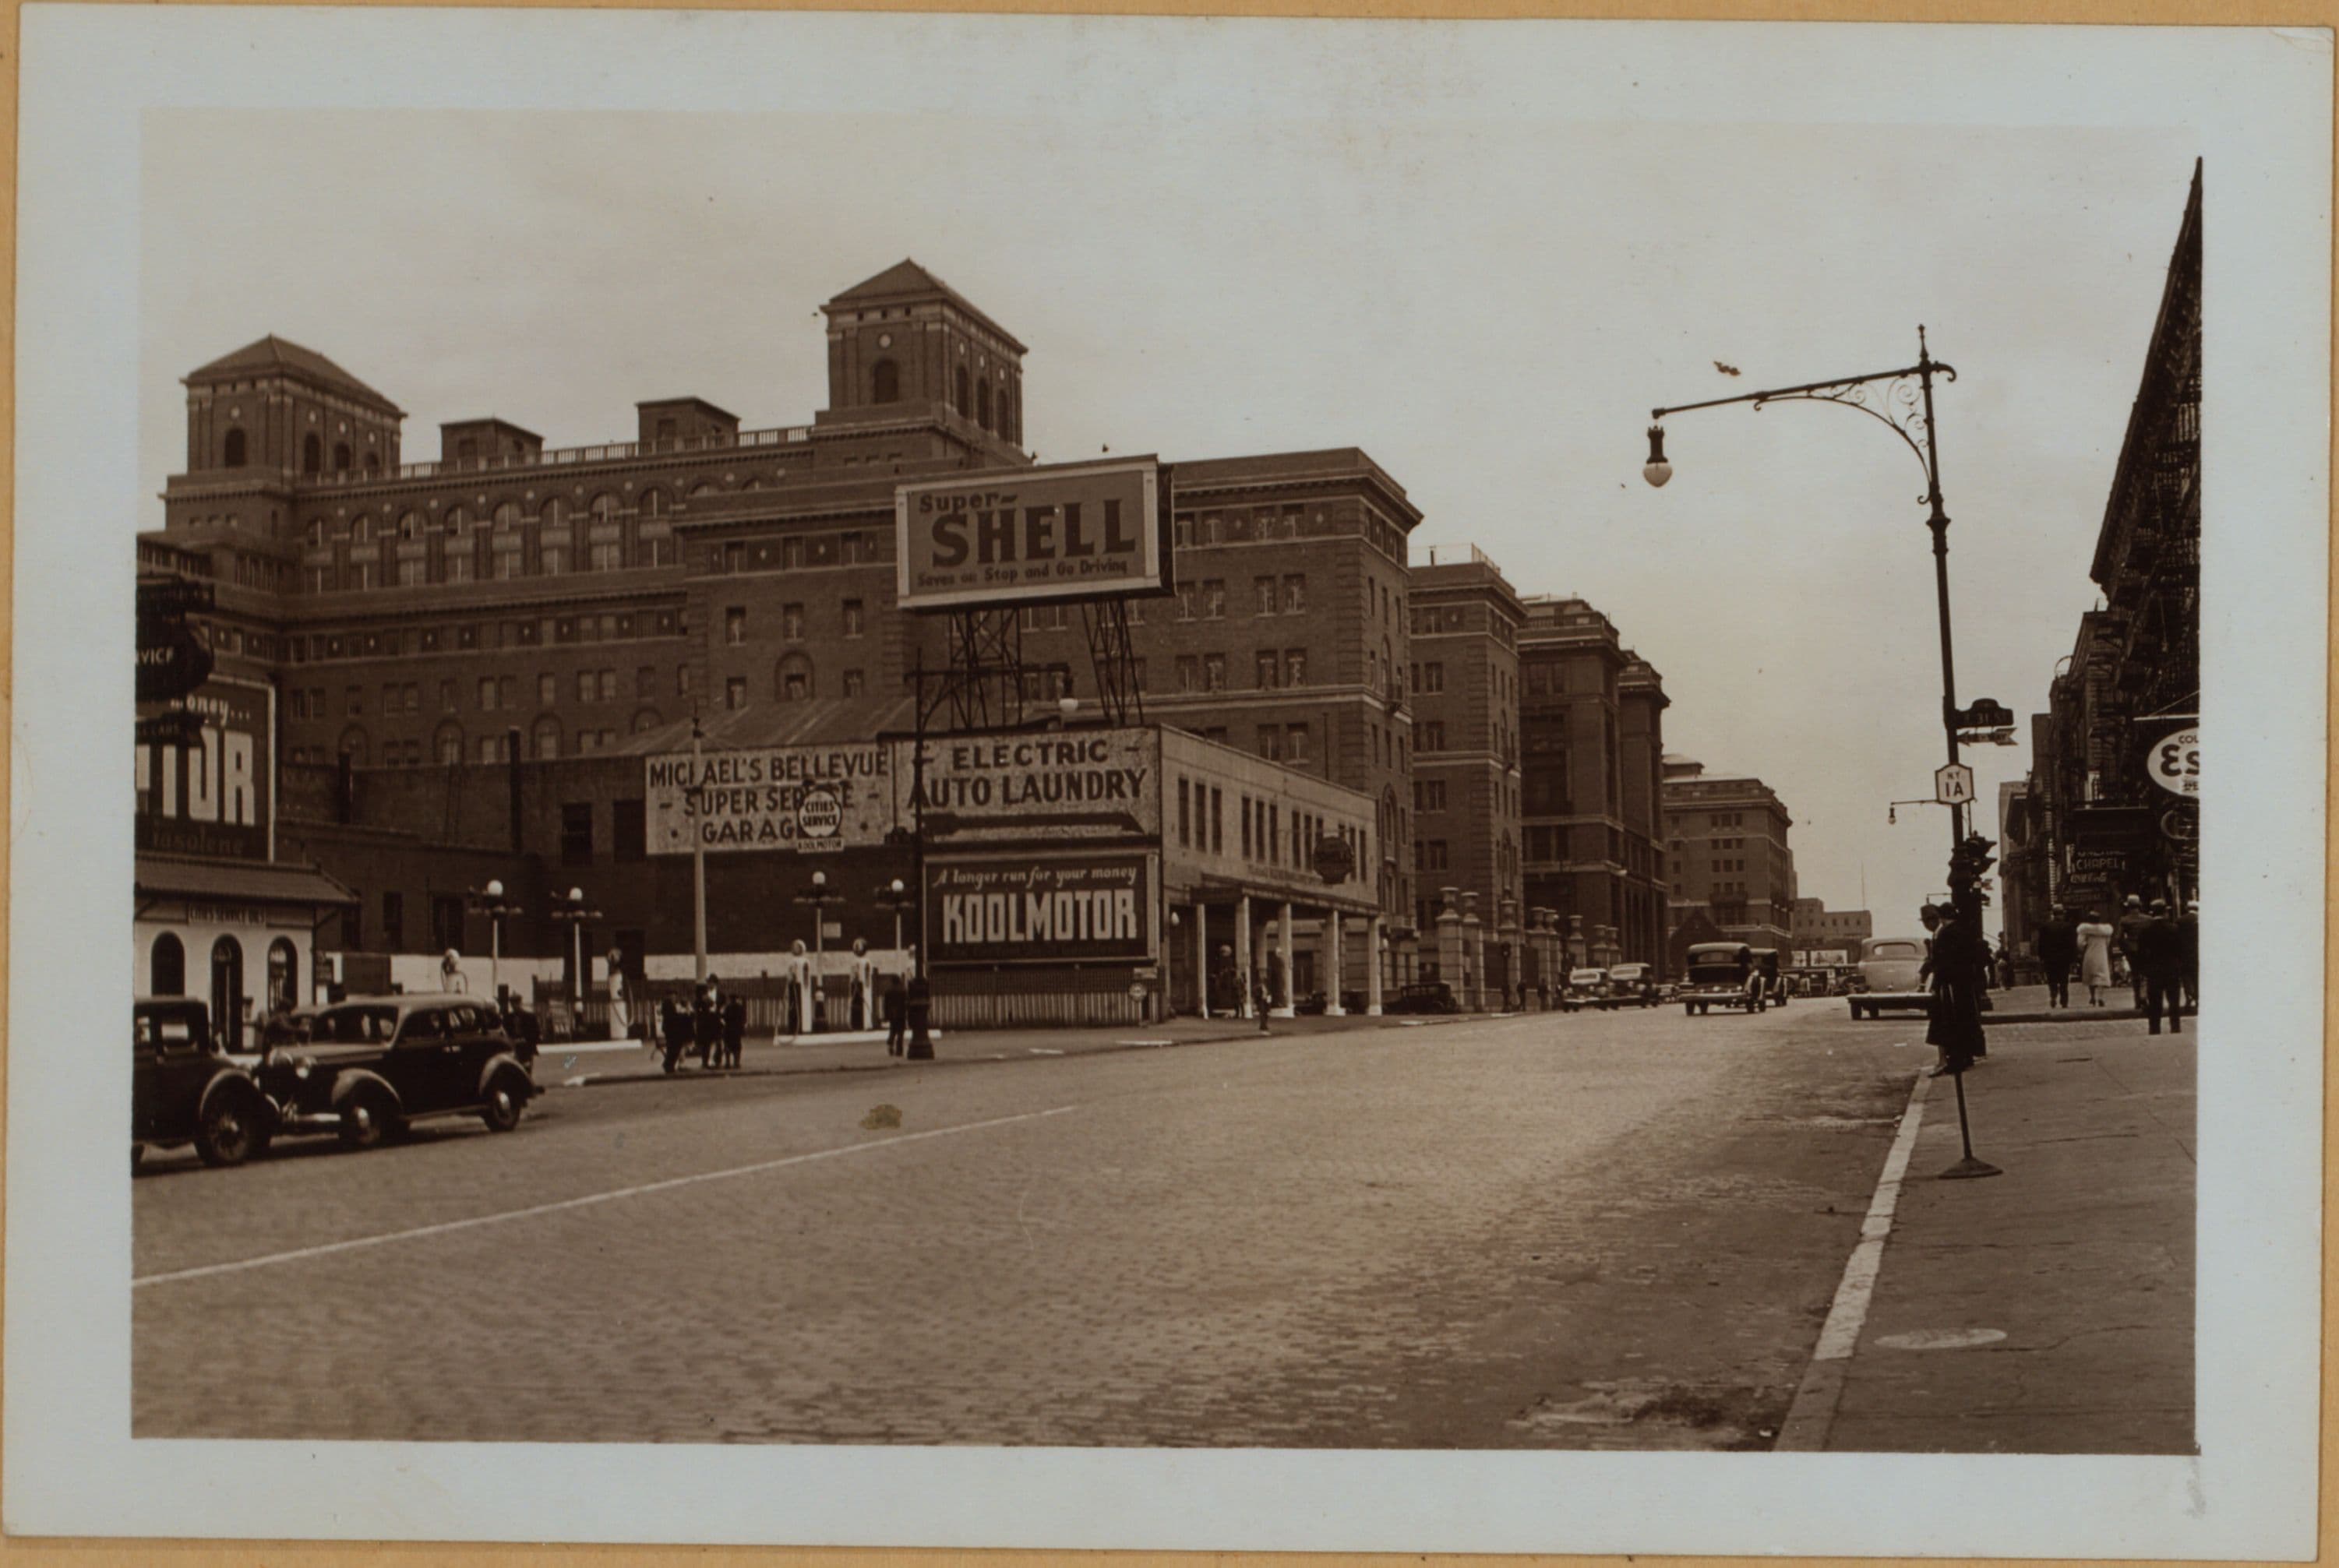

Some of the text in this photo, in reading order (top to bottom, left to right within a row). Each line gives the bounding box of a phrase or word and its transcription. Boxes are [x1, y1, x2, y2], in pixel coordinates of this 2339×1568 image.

[931, 499, 1136, 568] SHELL
[984, 565, 1018, 583] Stop
[1025, 564, 1050, 579] and
[1056, 560, 1074, 575] Go
[1080, 558, 1127, 575] Driving
[770, 750, 889, 780] BELLEVUE
[952, 740, 1109, 770] ELECTRIC
[684, 780, 855, 816] SUPER SERE
[907, 768, 1148, 809] AUTO LAUNDRY
[803, 814, 837, 827] SERVICE
[805, 800, 834, 813] CITIES
[702, 817, 796, 844] GARAG
[932, 866, 1138, 891] A longer run for your money
[943, 889, 1138, 944] KOOLMOTOR
